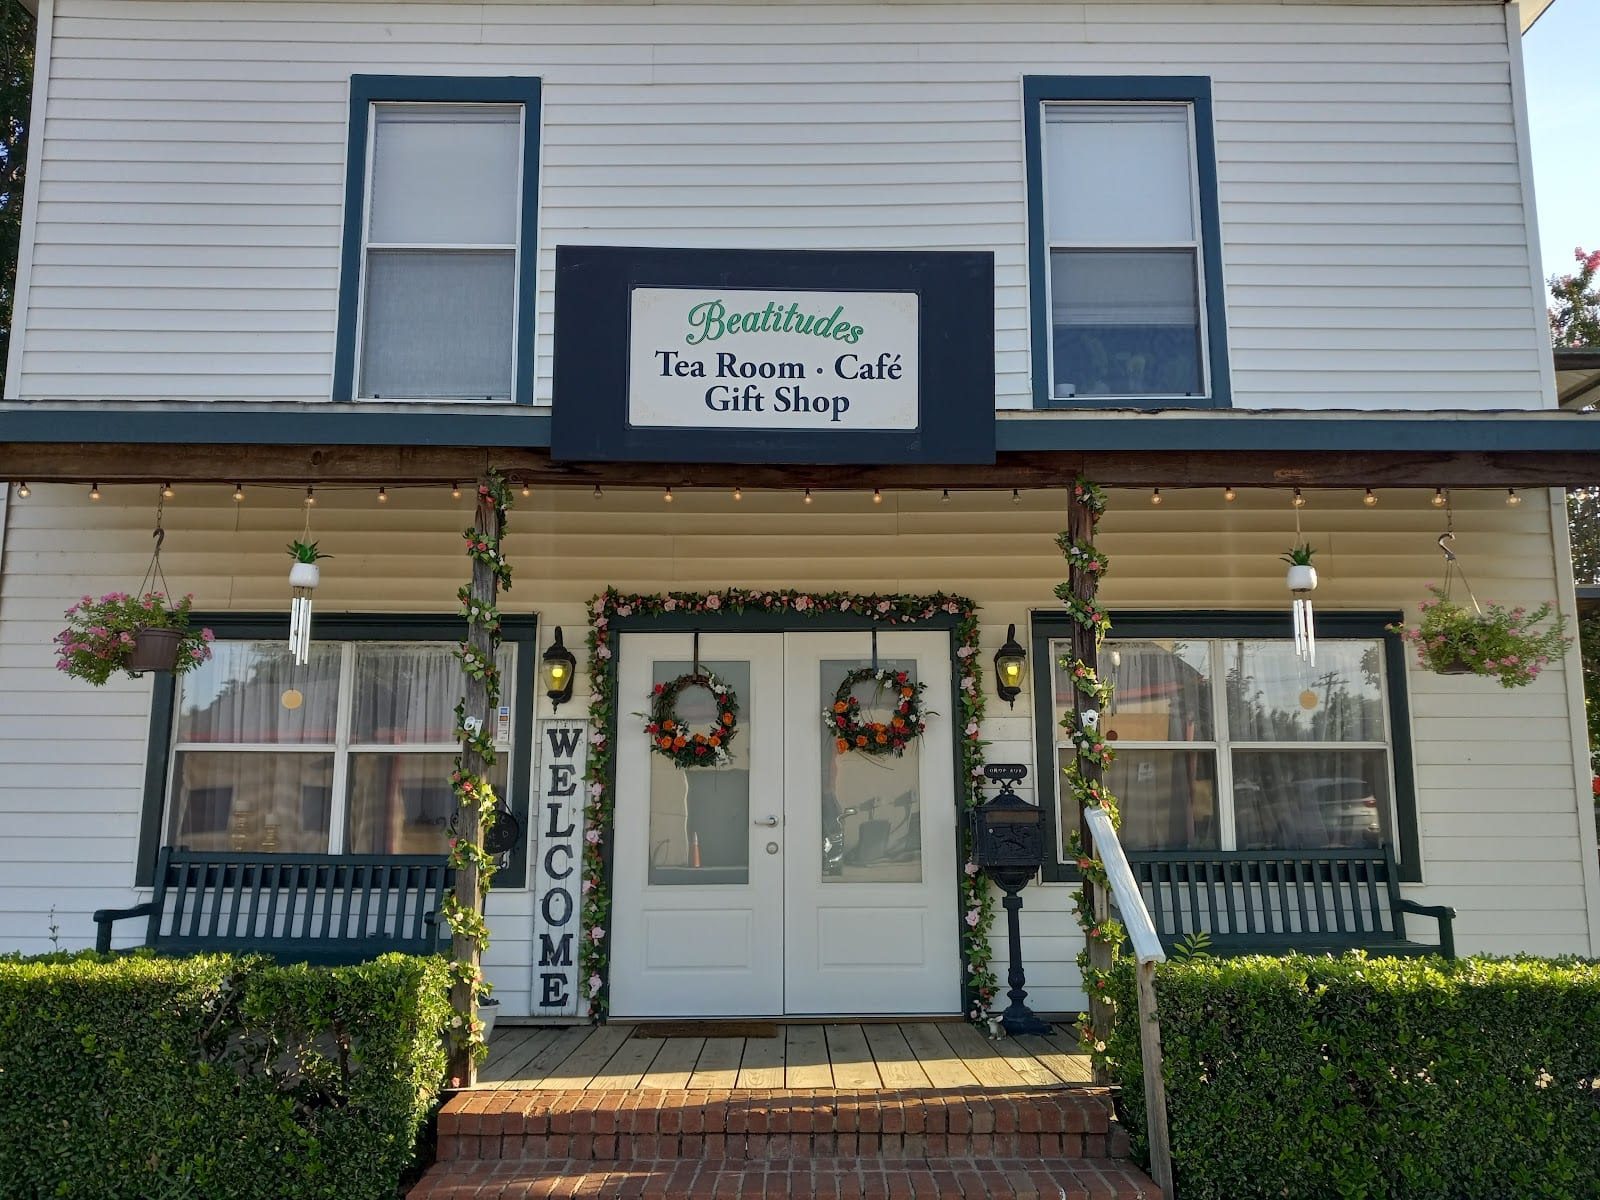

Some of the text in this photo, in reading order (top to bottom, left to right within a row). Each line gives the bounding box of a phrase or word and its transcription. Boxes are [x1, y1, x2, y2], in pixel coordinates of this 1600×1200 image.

[685, 299, 865, 346] Beatitudes
[655, 350, 903, 380] Tea Room Café
[705, 385, 850, 422] Gift Shop
[538, 728, 583, 1007] WELCOME
